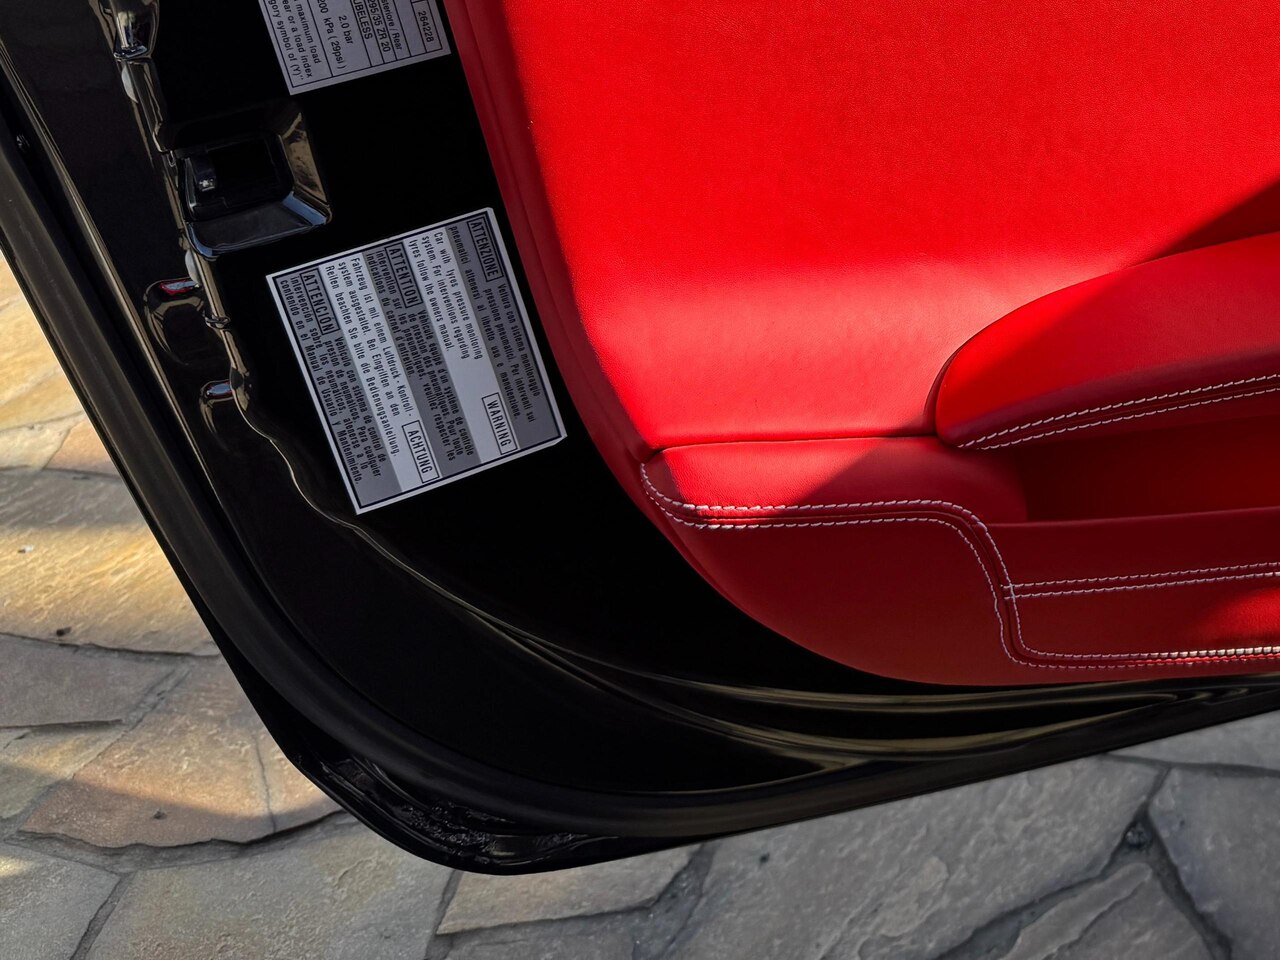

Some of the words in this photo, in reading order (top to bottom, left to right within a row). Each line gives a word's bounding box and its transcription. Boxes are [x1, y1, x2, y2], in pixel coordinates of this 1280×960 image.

[295, 3, 314, 44] maximum
[309, 45, 322, 64] load
[338, 15, 350, 29] 2.0
[376, 27, 388, 40] ZR
[417, 10, 435, 43] 264228
[276, 20, 294, 51] symbol
[287, 53, 298, 62] of
[287, 15, 296, 24] or
[294, 34, 306, 53] load
[300, 55, 313, 78] index
[323, 17, 334, 34] kPa
[330, 40, 344, 64] 29psi
[343, 29, 353, 44] bar
[380, 41, 391, 52] 20
[391, 32, 402, 50] Rear
